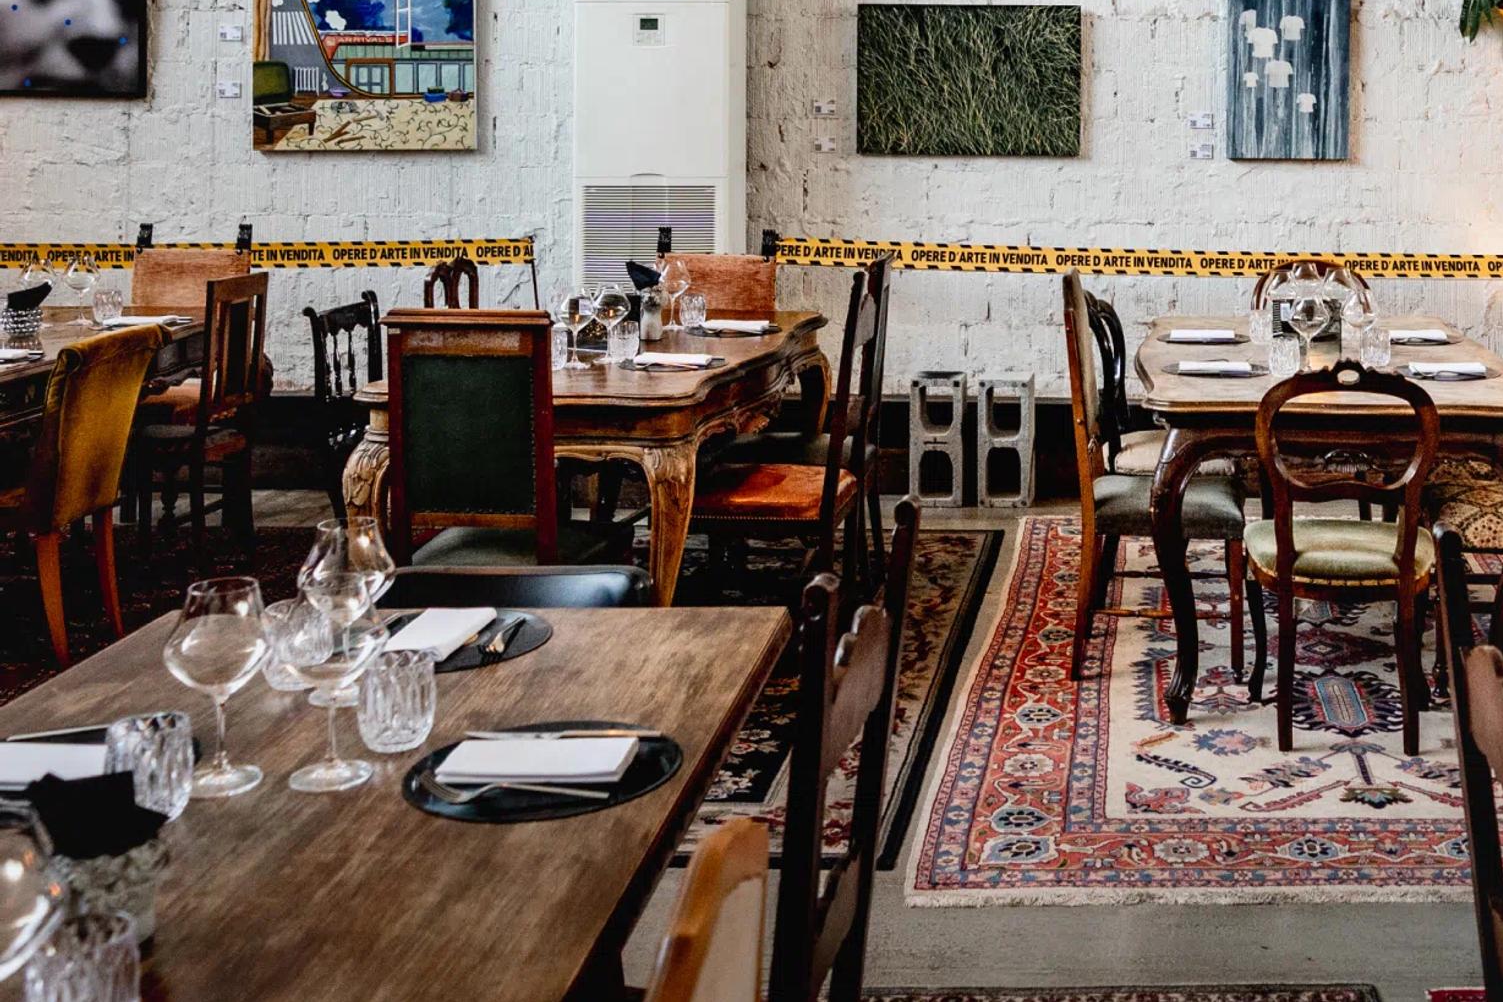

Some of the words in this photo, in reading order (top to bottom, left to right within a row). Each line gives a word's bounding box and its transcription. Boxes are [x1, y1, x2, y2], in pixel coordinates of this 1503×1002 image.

[0, 250, 40, 262] ENDITA
[124, 250, 135, 263] IN
[266, 249, 277, 262] IN
[279, 249, 325, 262] VENDITA
[333, 248, 367, 261] OPERE
[410, 247, 420, 260] IN
[422, 246, 468, 260] VENDITA
[476, 245, 511, 259] OPERE
[776, 244, 801, 258] PERE
[844, 247, 855, 260] IN
[857, 248, 903, 262] VENDTA
[911, 250, 946, 264] OPERE
[989, 252, 1000, 265] IN
[1002, 253, 1048, 266] VENDITA
[1056, 254, 1090, 267] OPERE
[1134, 256, 1144, 268] IN
[1147, 256, 1192, 269] VENDITA
[1200, 257, 1235, 270] OPERE
[1345, 259, 1379, 272] OPERE
[1422, 260, 1432, 273] IN
[1434, 260, 1480, 273] VENDITA
